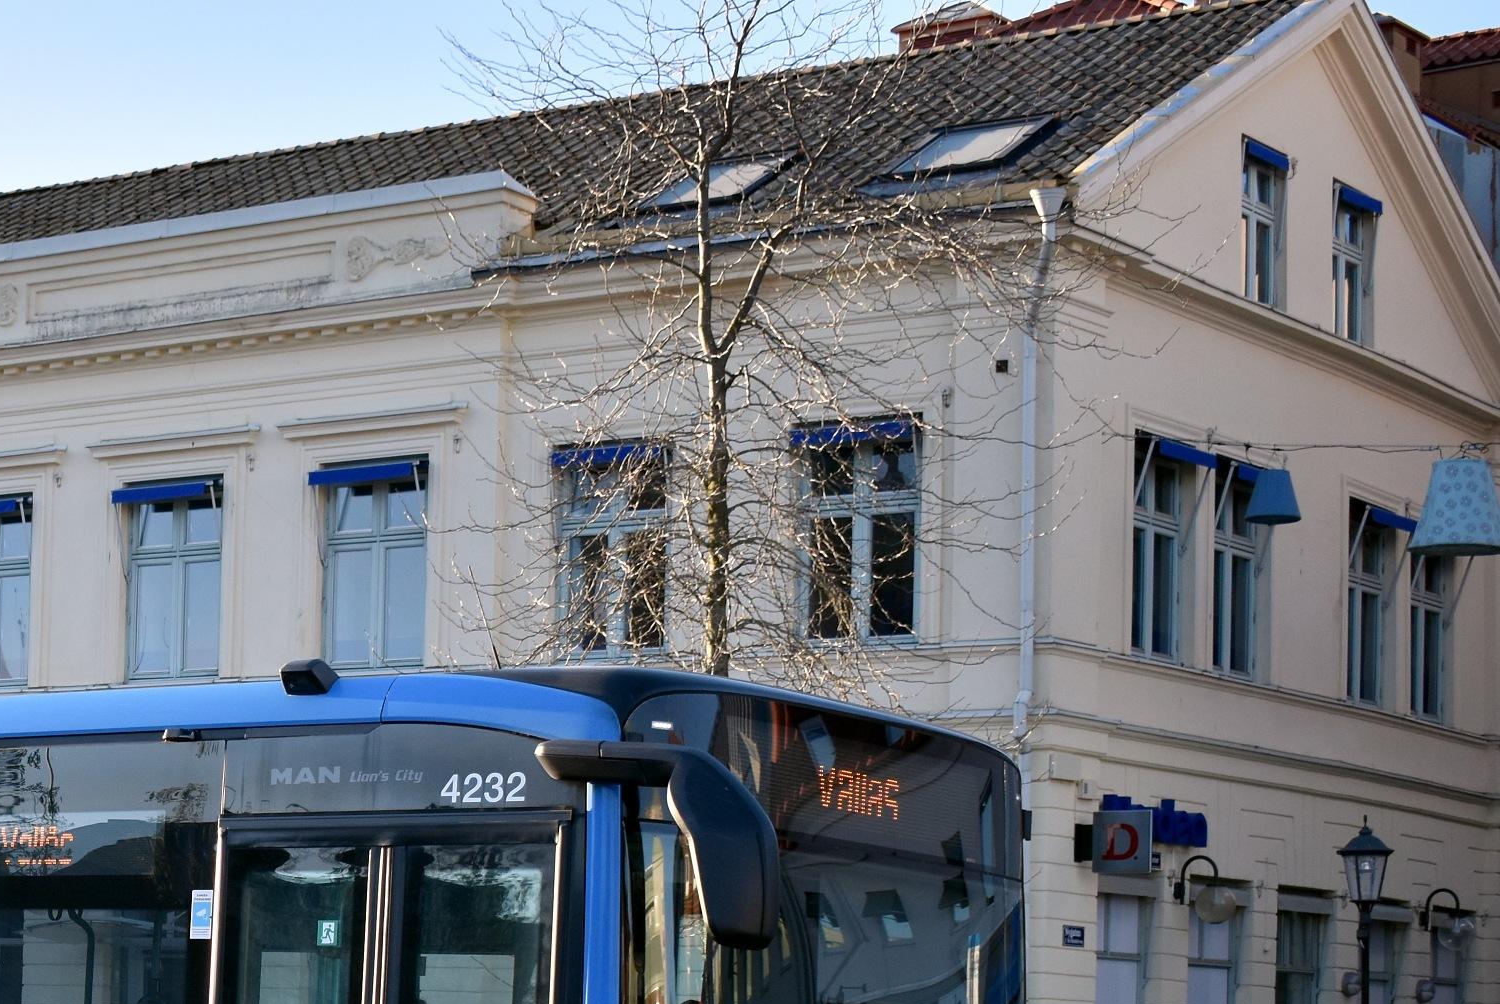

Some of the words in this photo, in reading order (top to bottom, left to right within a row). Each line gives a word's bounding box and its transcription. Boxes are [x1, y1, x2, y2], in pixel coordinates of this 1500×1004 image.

[270, 766, 341, 785] MAN
[350, 770, 389, 783] Lion's
[395, 769, 424, 784] City
[440, 771, 527, 804] 4232
